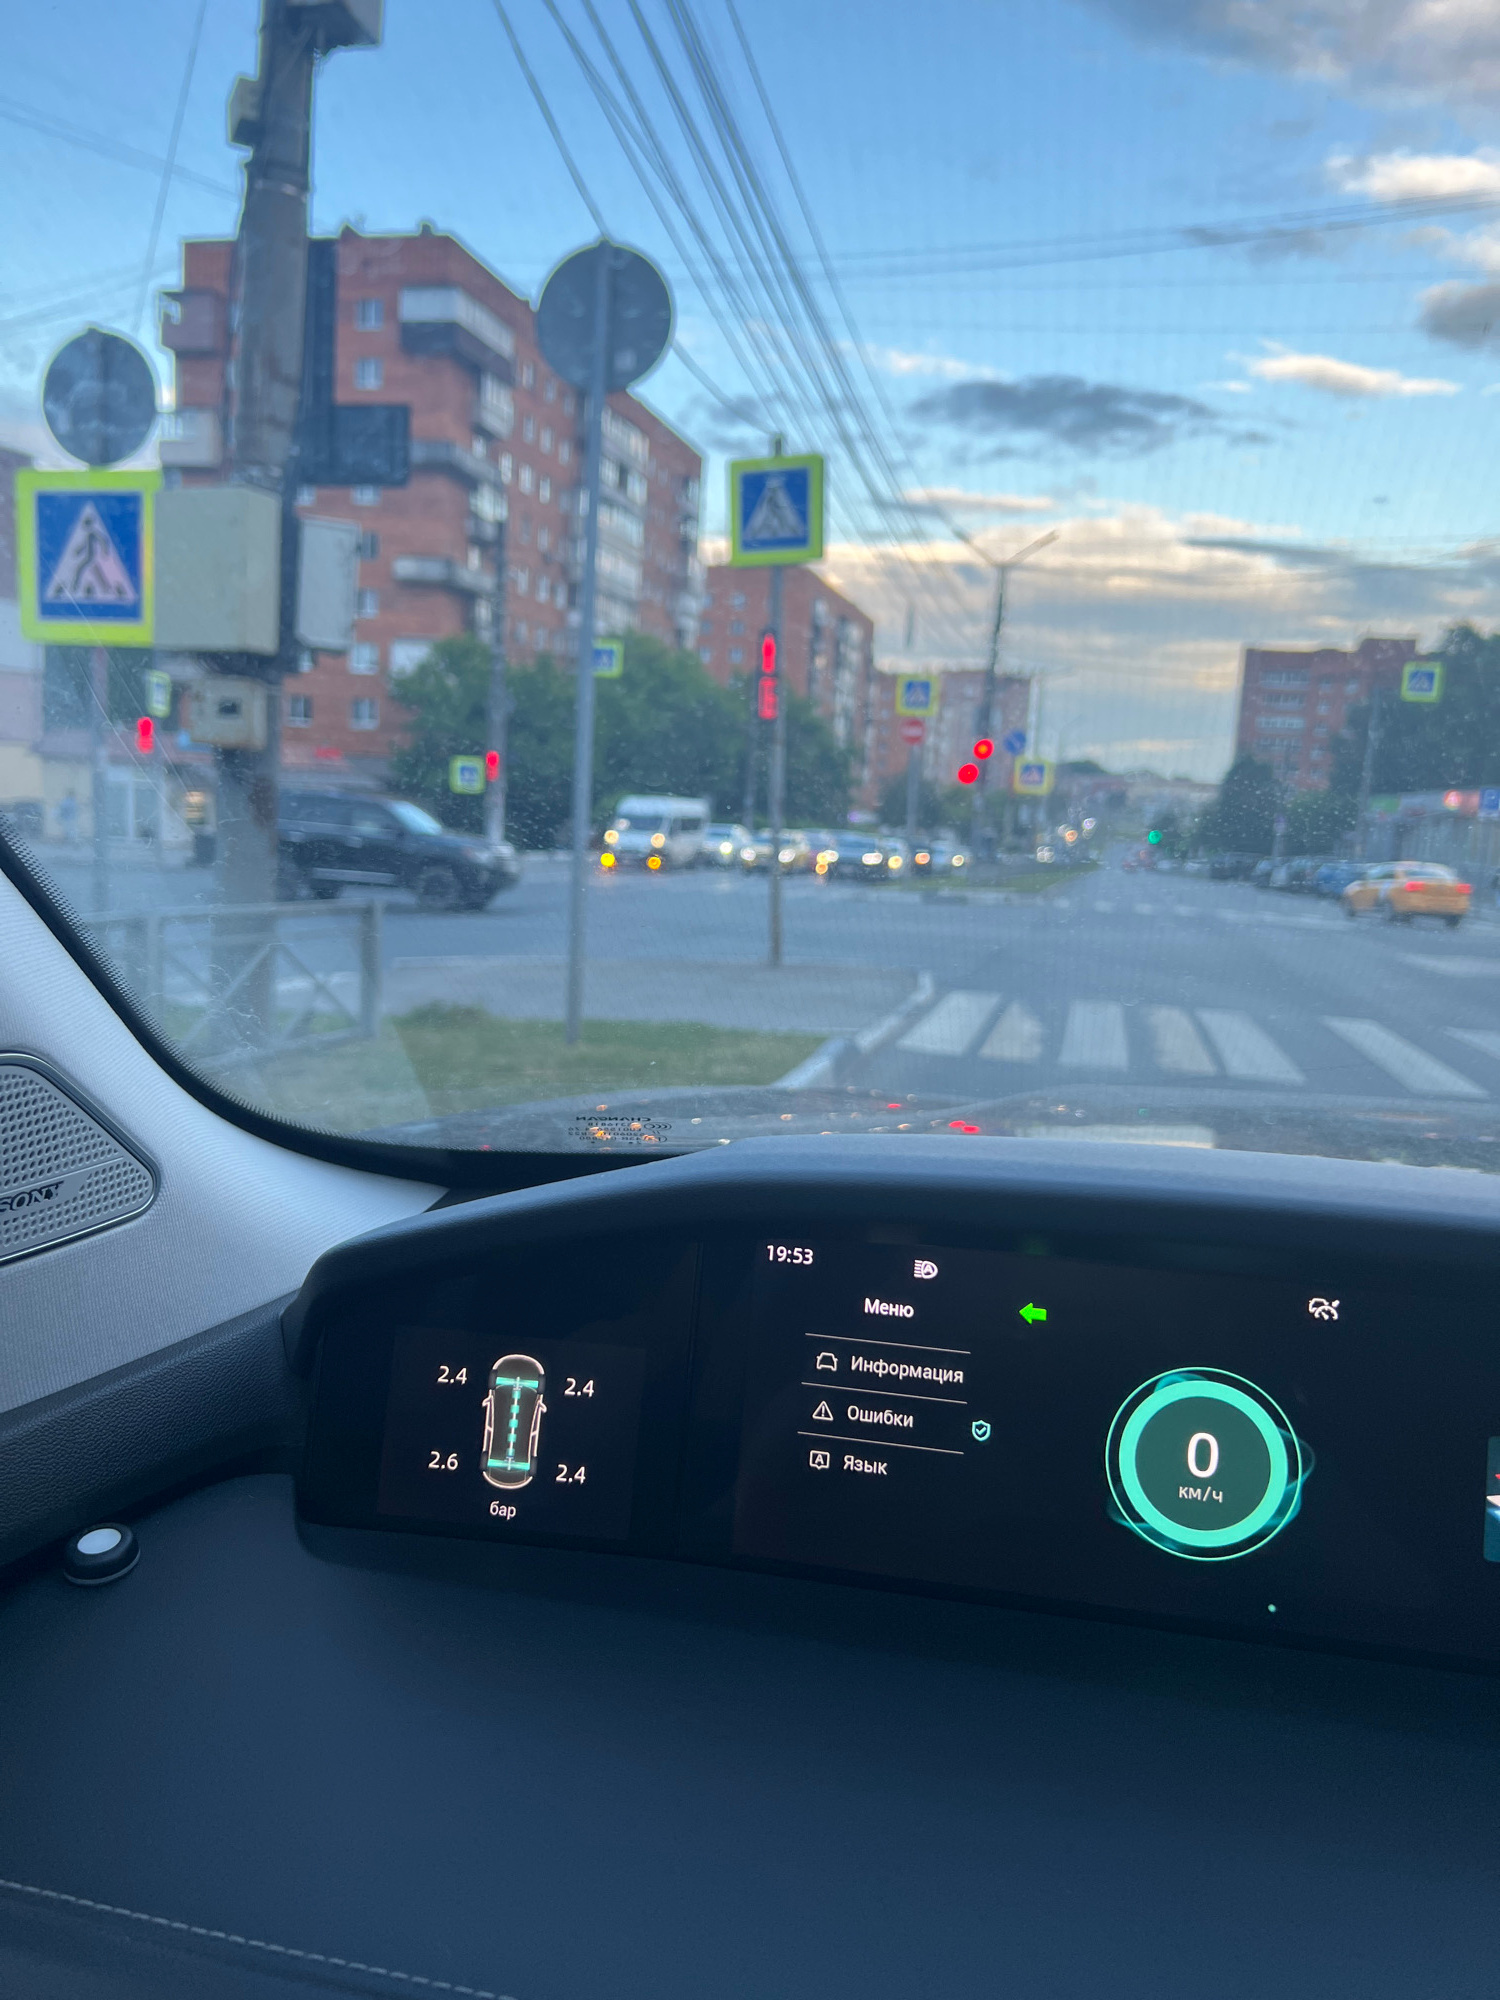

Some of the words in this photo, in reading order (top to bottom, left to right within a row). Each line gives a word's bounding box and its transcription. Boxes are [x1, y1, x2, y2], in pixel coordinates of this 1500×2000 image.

[767, 1245, 813, 1264] 19:53
[865, 1298, 914, 1317] Меню
[438, 1366, 467, 1384] 2.4
[851, 1356, 963, 1384] Информация
[565, 1378, 594, 1397] 2.4
[848, 1406, 913, 1427] Ошибки
[429, 1451, 458, 1470] 2.6
[844, 1455, 887, 1475] Язык
[1188, 1433, 1218, 1478] 0
[556, 1464, 585, 1484] 2.4
[490, 1501, 516, 1520] бар
